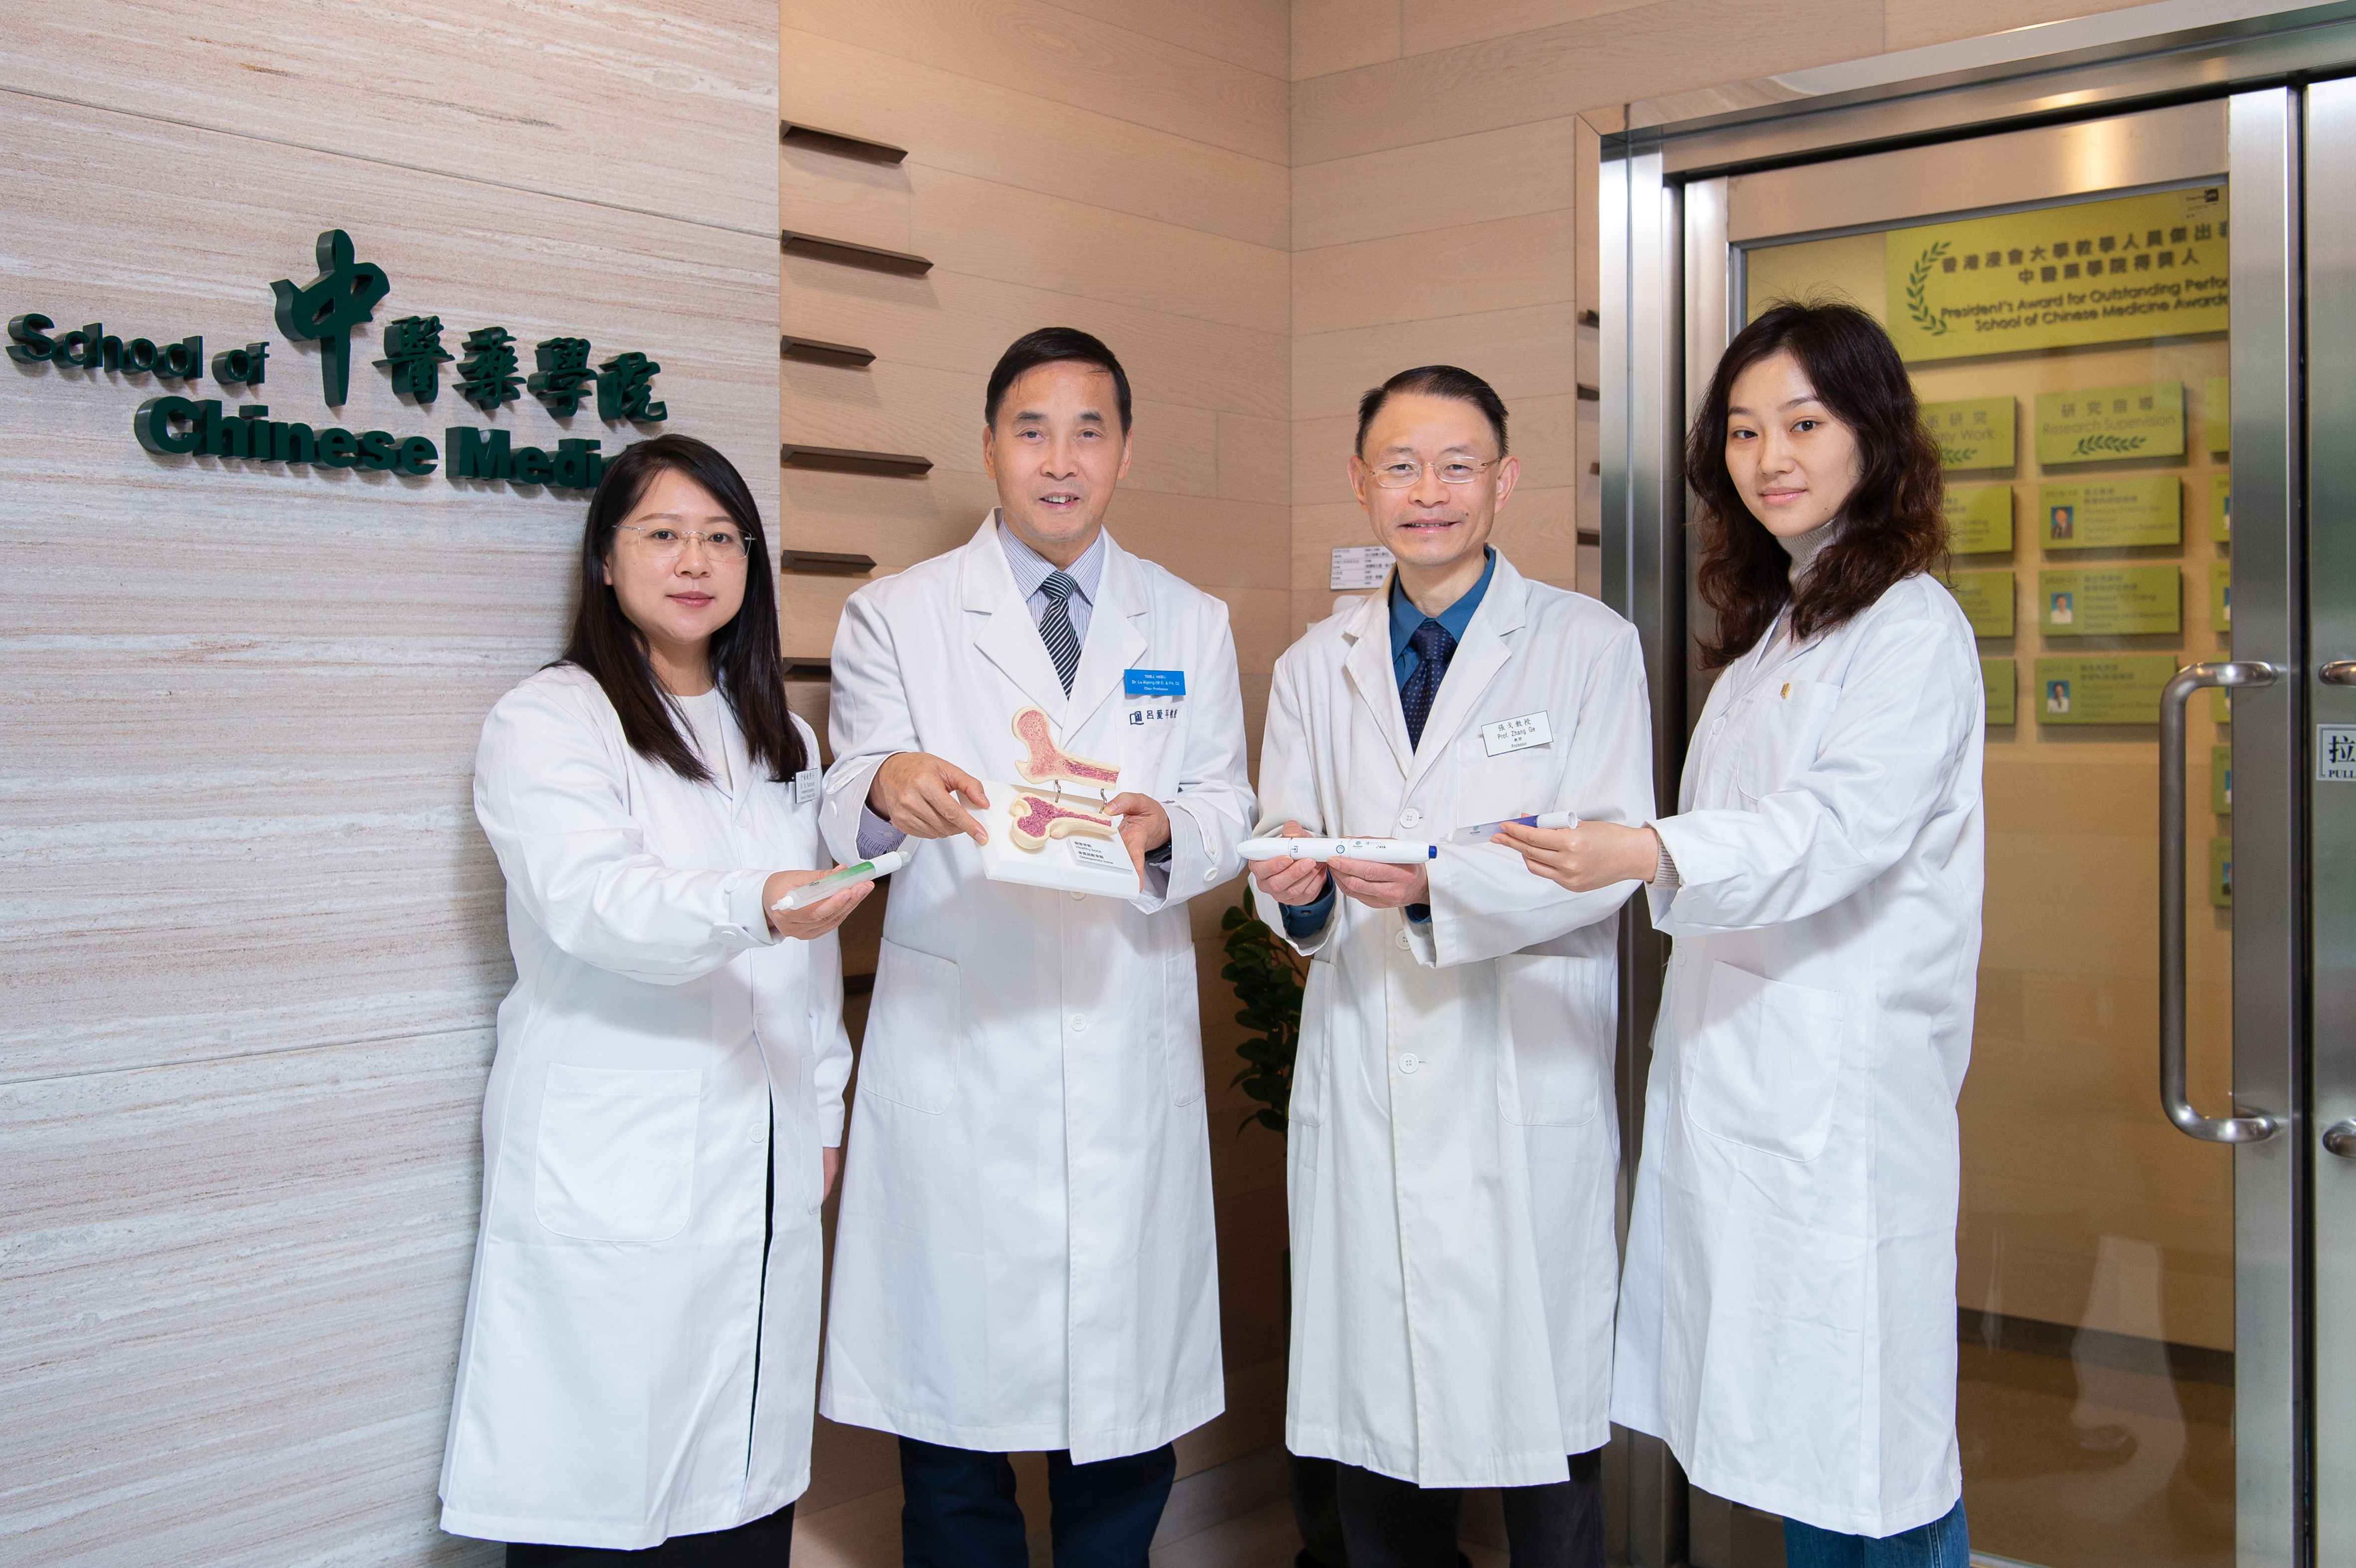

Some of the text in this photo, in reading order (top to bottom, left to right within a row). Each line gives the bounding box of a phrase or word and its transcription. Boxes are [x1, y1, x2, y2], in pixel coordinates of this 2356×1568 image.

[1941, 301, 2013, 318] President's
[2018, 295, 2063, 310] Award
[2067, 292, 2086, 305] for
[2090, 283, 2181, 303] Outstanding
[1975, 315, 2020, 332] School
[2024, 313, 2038, 327] of
[2042, 308, 2098, 324] Chinese
[2101, 301, 2170, 317] Medicine
[5, 313, 270, 385] School of
[2043, 415, 2175, 435] Research Supervision
[134, 395, 622, 490] Chinese Medi
[2328, 735, 2356, 764] 拉
[2328, 769, 2356, 779] PULL
